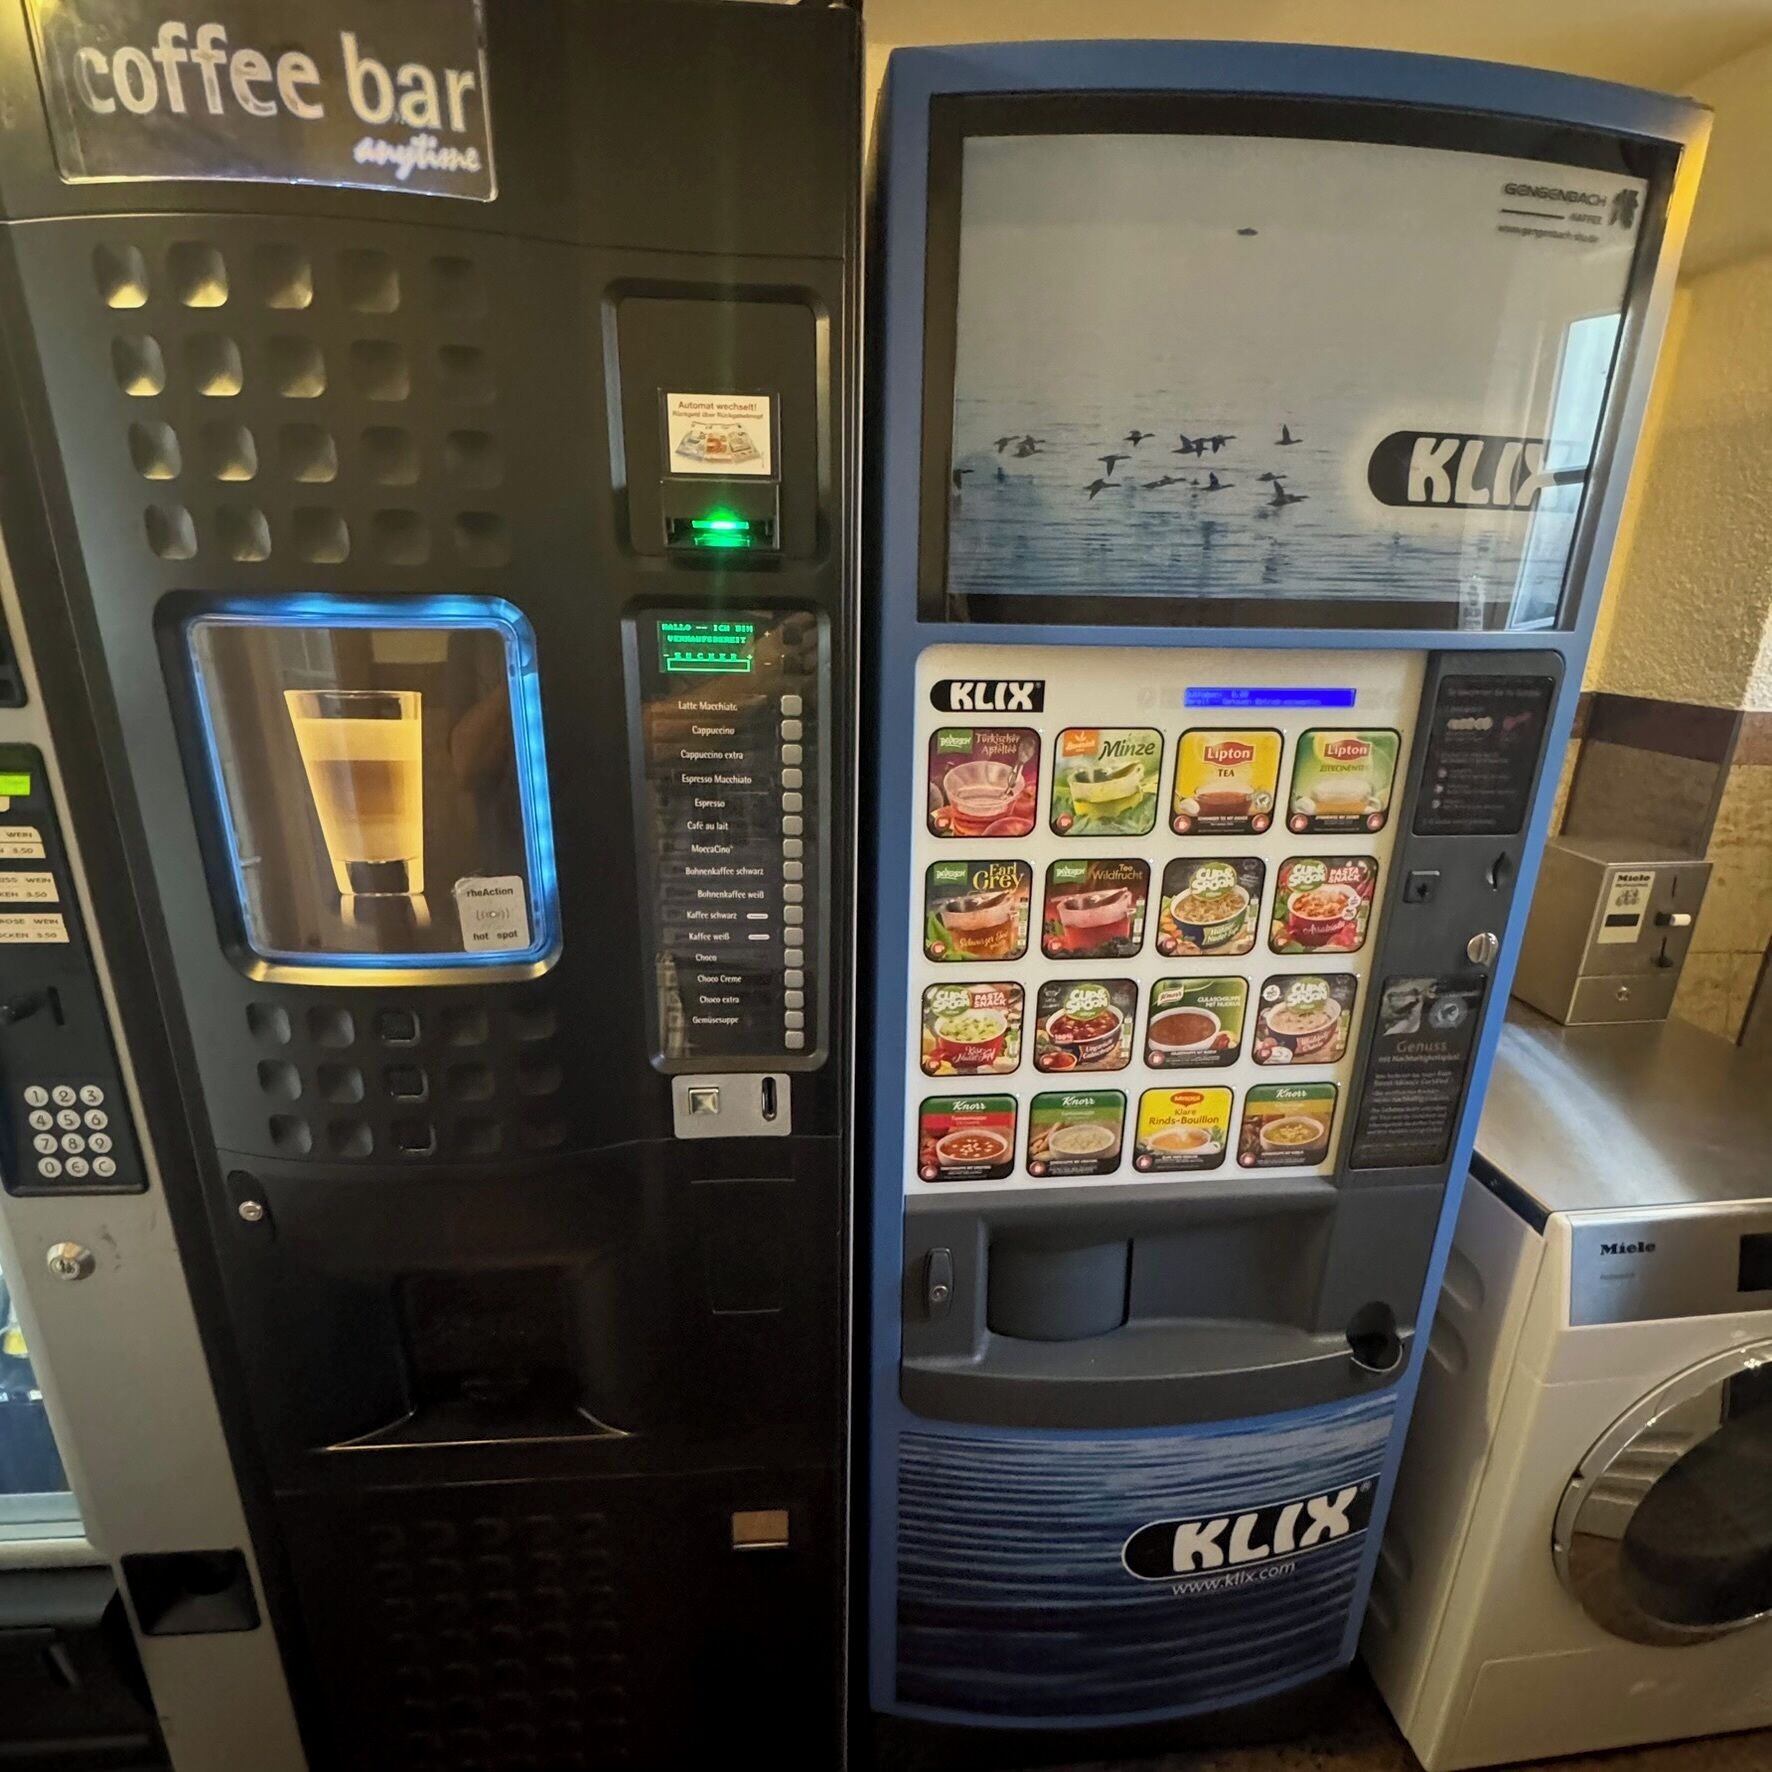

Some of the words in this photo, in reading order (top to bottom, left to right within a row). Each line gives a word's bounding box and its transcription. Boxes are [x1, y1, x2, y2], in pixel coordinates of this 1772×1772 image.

[75, 21, 324, 119] coffee
[341, 31, 476, 132] bar
[354, 134, 482, 180] anytime
[679, 401, 714, 410] Automat
[716, 403, 757, 412] wechselt!
[950, 682, 1034, 710] KLIX
[678, 701, 698, 710] Latte
[692, 725, 735, 736] Cappuccino
[680, 750, 723, 761] Cappuccino
[724, 751, 744, 760] extra
[1098, 740, 1156, 760] Minze
[1327, 743, 1368, 762] Lipton
[1207, 746, 1251, 766] Lipton
[681, 774, 713, 784] Espresso
[714, 774, 752, 784] Macchiato
[1218, 769, 1235, 778] TEA
[694, 798, 726, 809] Espresso
[687, 820, 703, 830] Café
[716, 822, 729, 831] lait
[685, 867, 735, 875] Bohnenkaffee
[736, 868, 764, 876] schwarz
[989, 862, 1017, 876] Earl
[1120, 864, 1133, 872] Tee
[1330, 867, 1359, 875] PASTA
[1093, 870, 1143, 880] Wildfrucht
[973, 870, 1025, 893] Grey
[697, 890, 746, 899] Bohnenkaffee
[748, 891, 765, 899] weiß
[687, 911, 709, 920] Kaffee
[710, 912, 737, 920] schwarz
[473, 932, 489, 940] hot
[497, 930, 518, 940] spot
[689, 932, 711, 941] Kaffee
[713, 932, 730, 941] weiß
[696, 954, 717, 962] Choco
[697, 975, 719, 983] Choco
[720, 975, 742, 983] Creme
[700, 996, 721, 1004] Choco
[722, 996, 740, 1004] extra
[975, 992, 1005, 1001] PASTA
[974, 999, 1006, 1008] SNACK
[1396, 1041, 1447, 1053] Genuss
[33, 1090, 39, 1103] 1
[58, 1090, 70, 1103] 2
[87, 1089, 97, 1103] 3
[1276, 1089, 1307, 1098] Knorr
[952, 1101, 986, 1111] Knorr
[1062, 1096, 1096, 1106] Knorr
[36, 1114, 46, 1127] 4
[63, 1114, 73, 1126] 5
[91, 1113, 101, 1126] 6
[41, 1138, 50, 1150] 7
[68, 1137, 78, 1150] 8
[95, 1137, 105, 1150] 9
[98, 1160, 108, 1173] C
[1600, 1242, 1656, 1255] Miele
[1173, 1486, 1358, 1572] KLIX
[1172, 1561, 1296, 1596] www.klix.com
